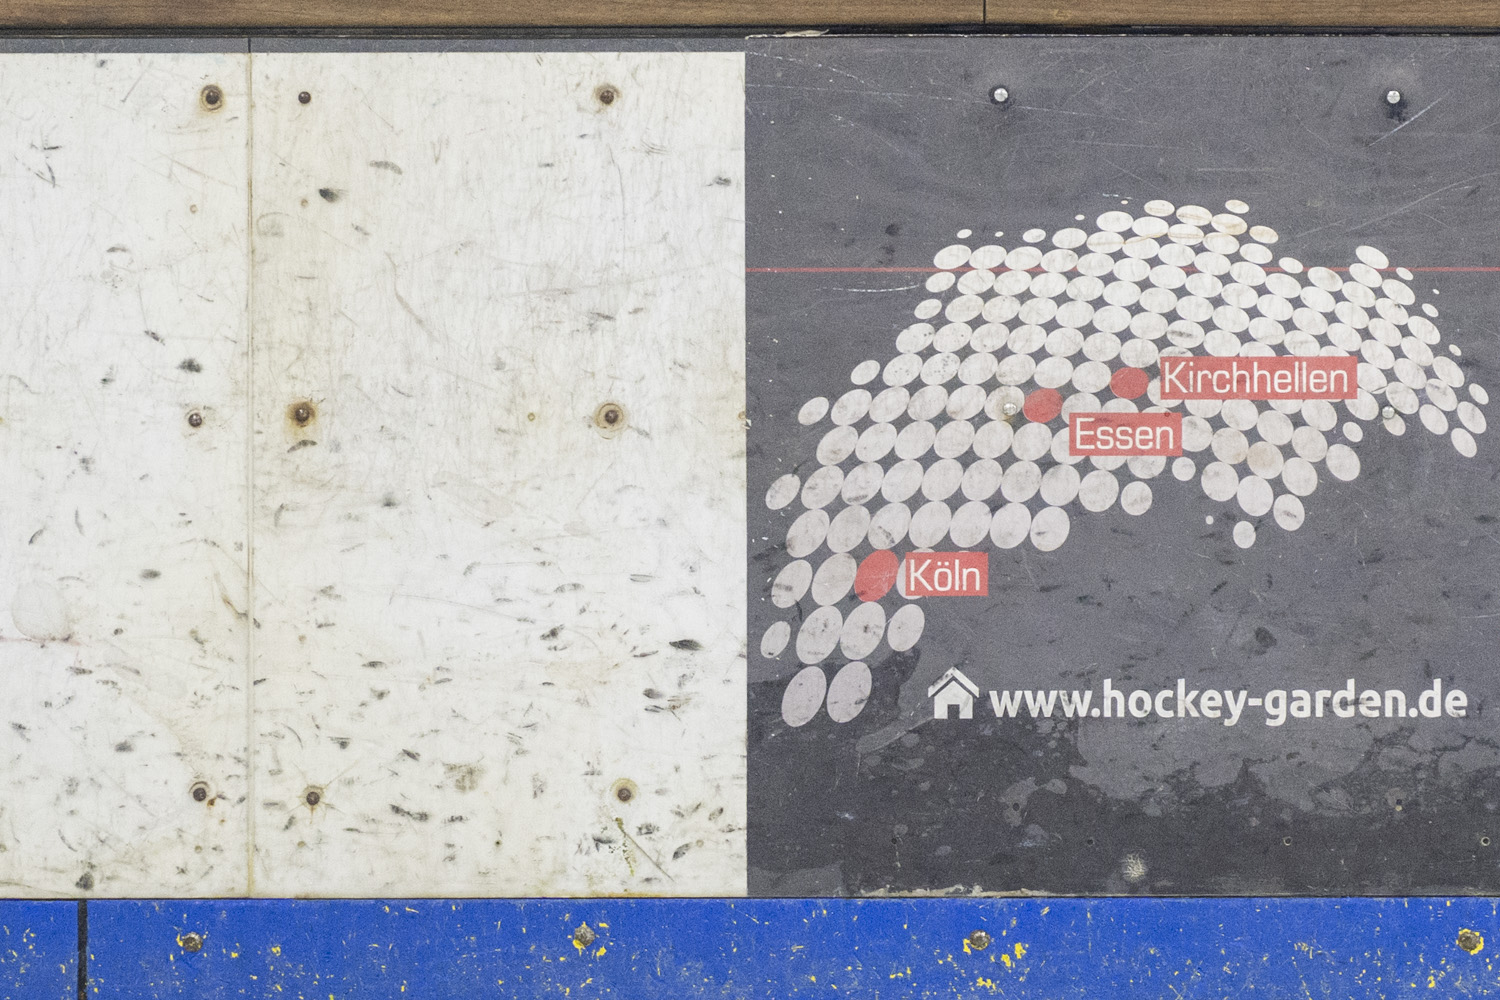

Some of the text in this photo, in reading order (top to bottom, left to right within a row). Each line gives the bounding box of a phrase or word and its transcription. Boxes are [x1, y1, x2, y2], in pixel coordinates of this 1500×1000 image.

[1163, 361, 1349, 395] Kirchhellen
[1074, 418, 1174, 451] Essen
[908, 559, 981, 594] Köln
[988, 678, 1469, 727] www.hockey-garden.de
